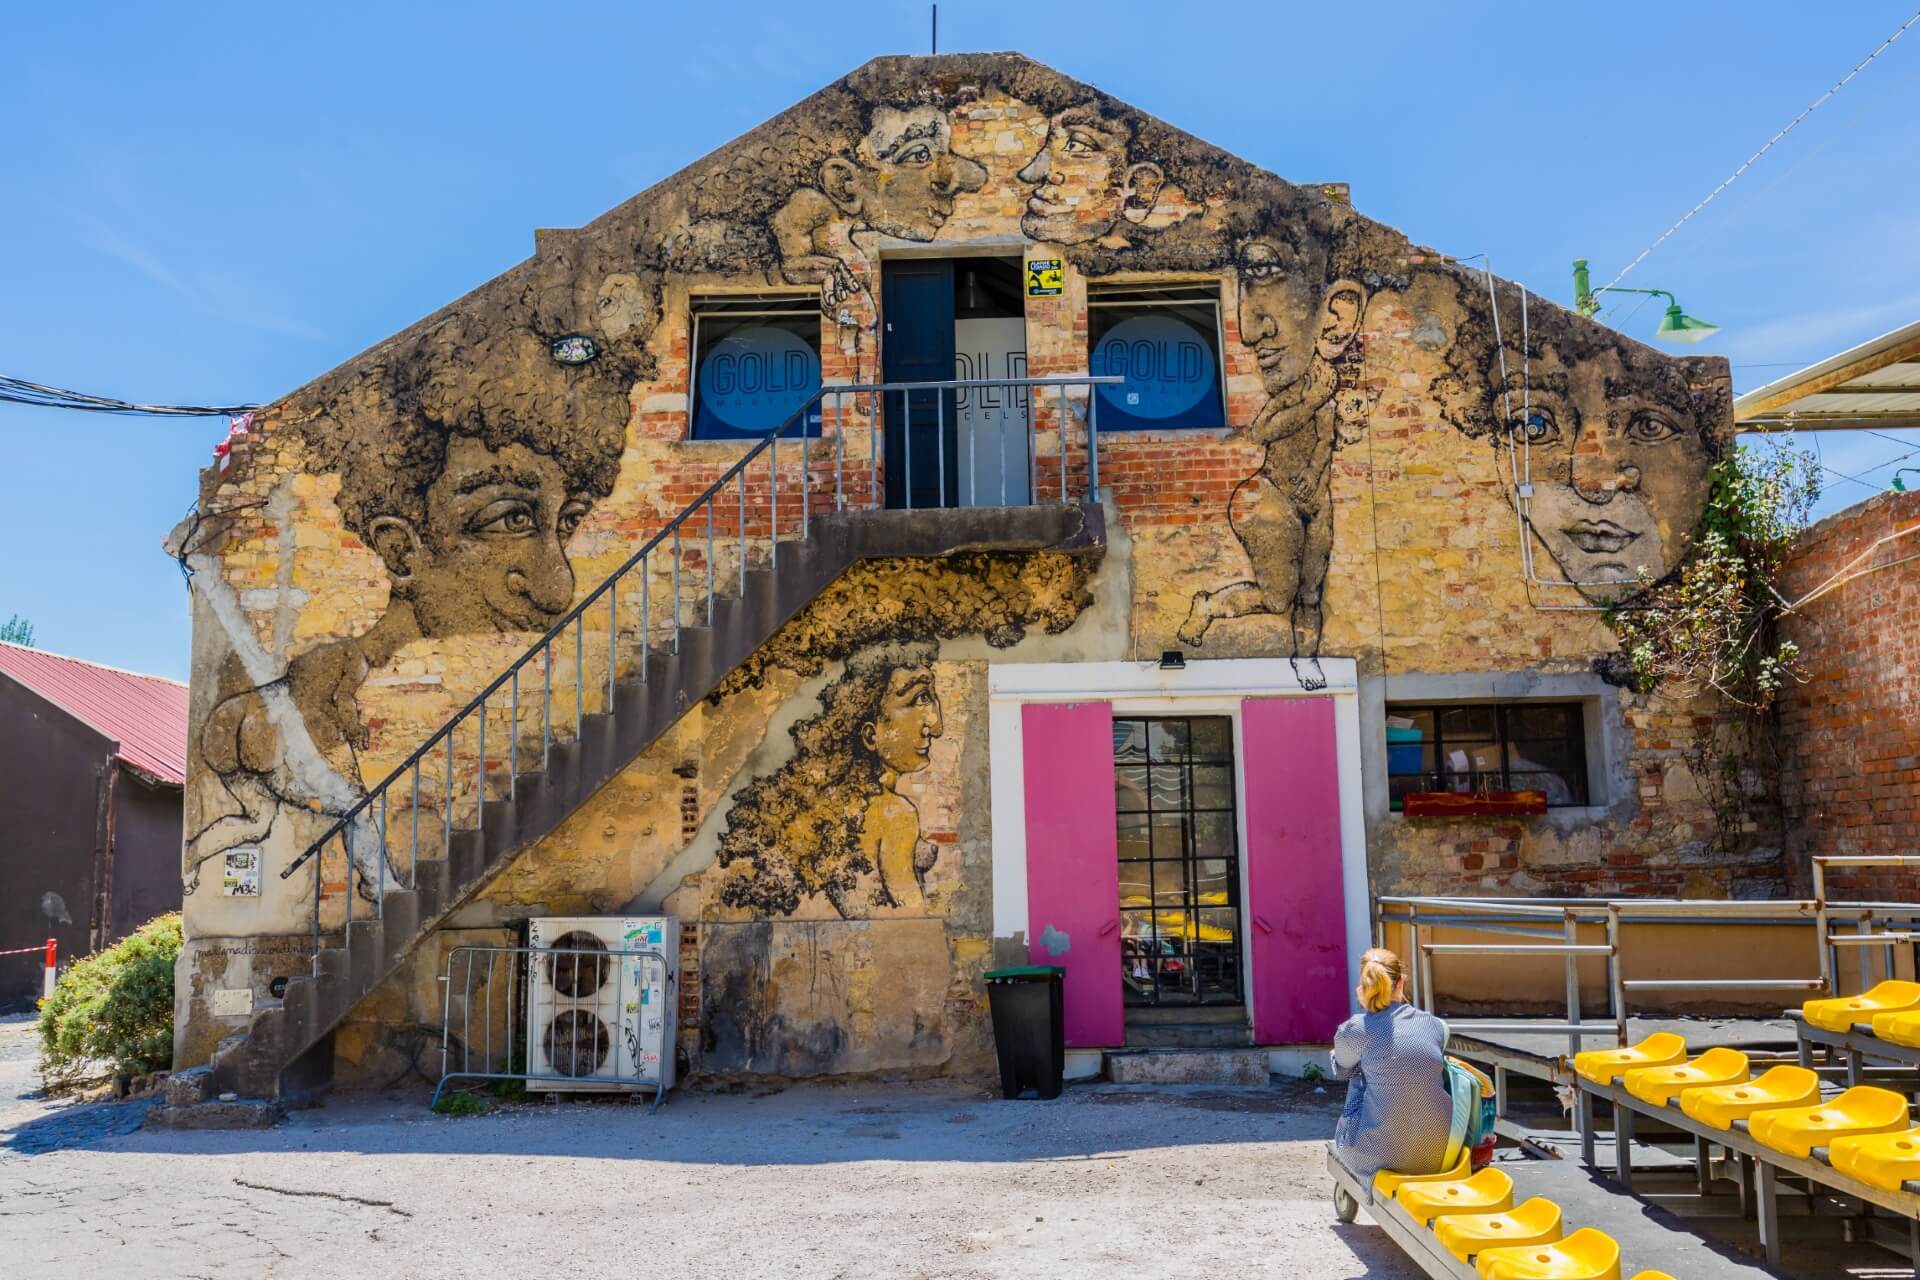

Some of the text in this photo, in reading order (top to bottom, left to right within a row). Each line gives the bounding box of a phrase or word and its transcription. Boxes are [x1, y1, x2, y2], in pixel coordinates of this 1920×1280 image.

[712, 350, 809, 395] GOLD
[956, 352, 1026, 410] OLD
[1104, 338, 1203, 383] GOLD
